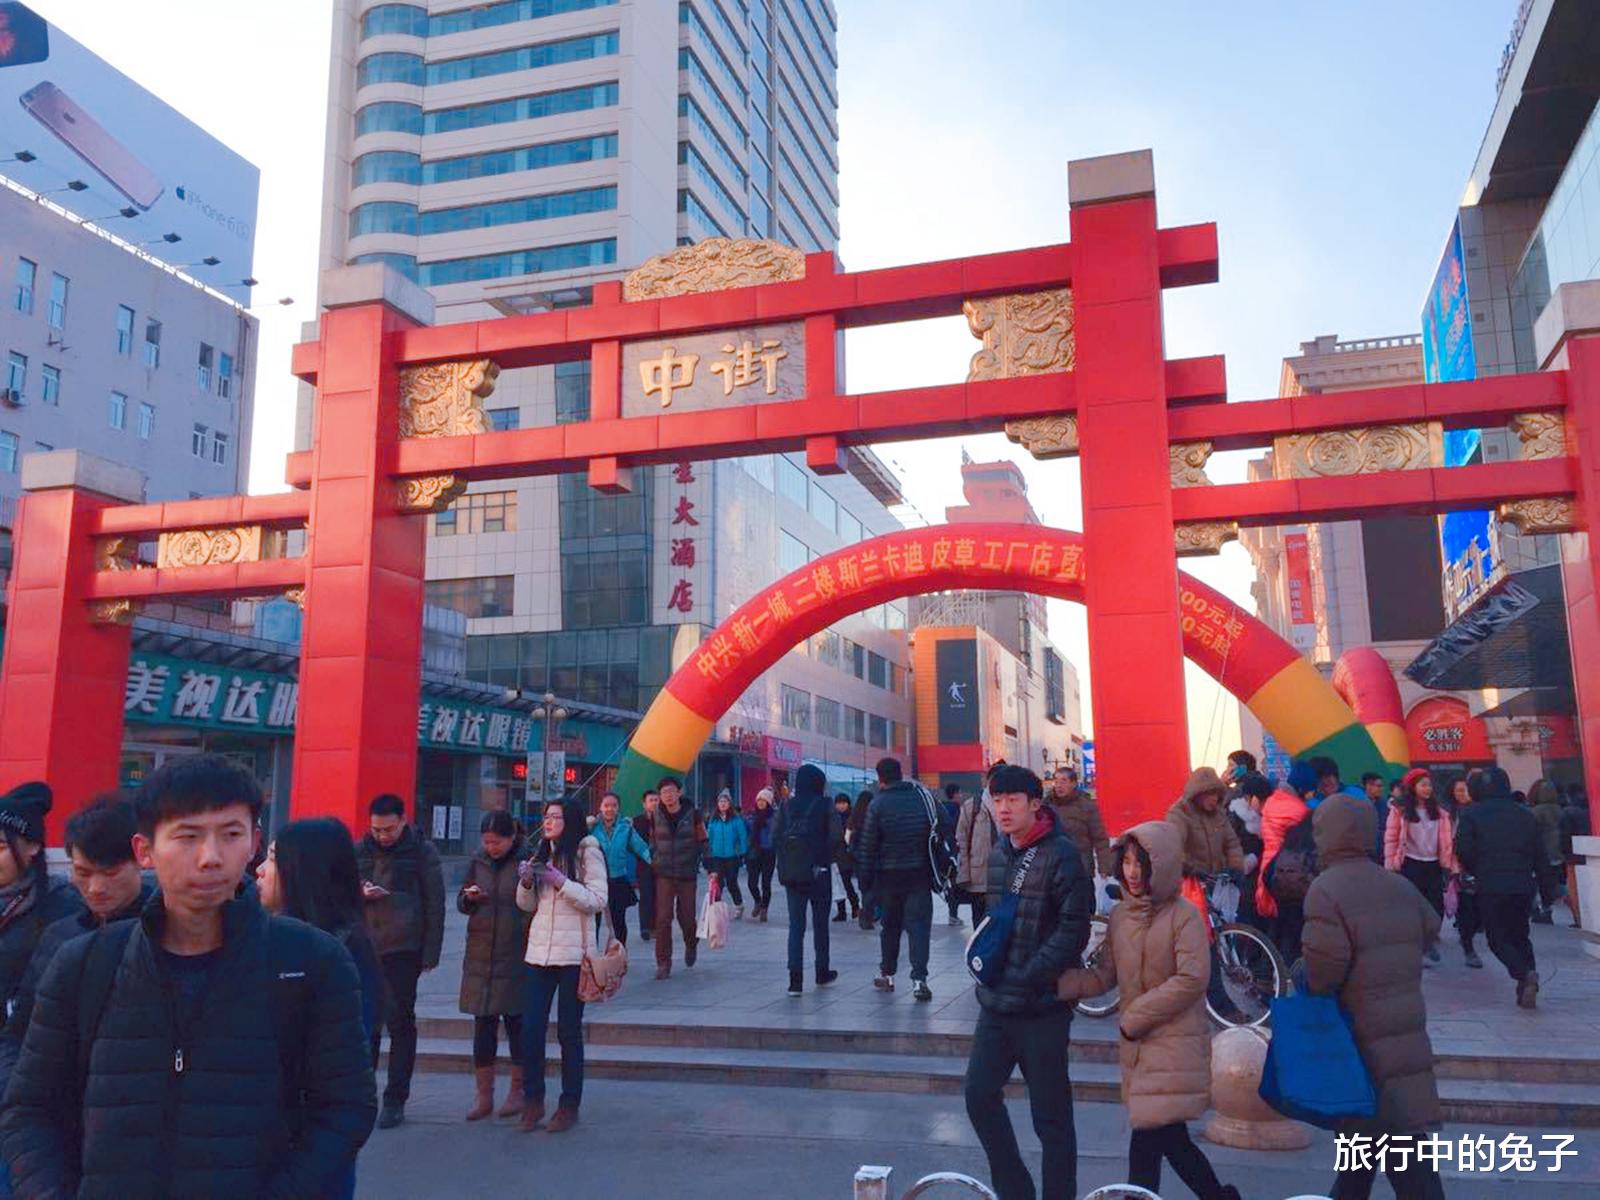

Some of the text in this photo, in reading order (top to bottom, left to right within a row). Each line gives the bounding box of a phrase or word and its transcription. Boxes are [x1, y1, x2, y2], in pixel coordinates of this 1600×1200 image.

[639, 340, 788, 408] 中街
[1180, 587, 1244, 639] 00元起
[1181, 611, 1231, 656] 0元起
